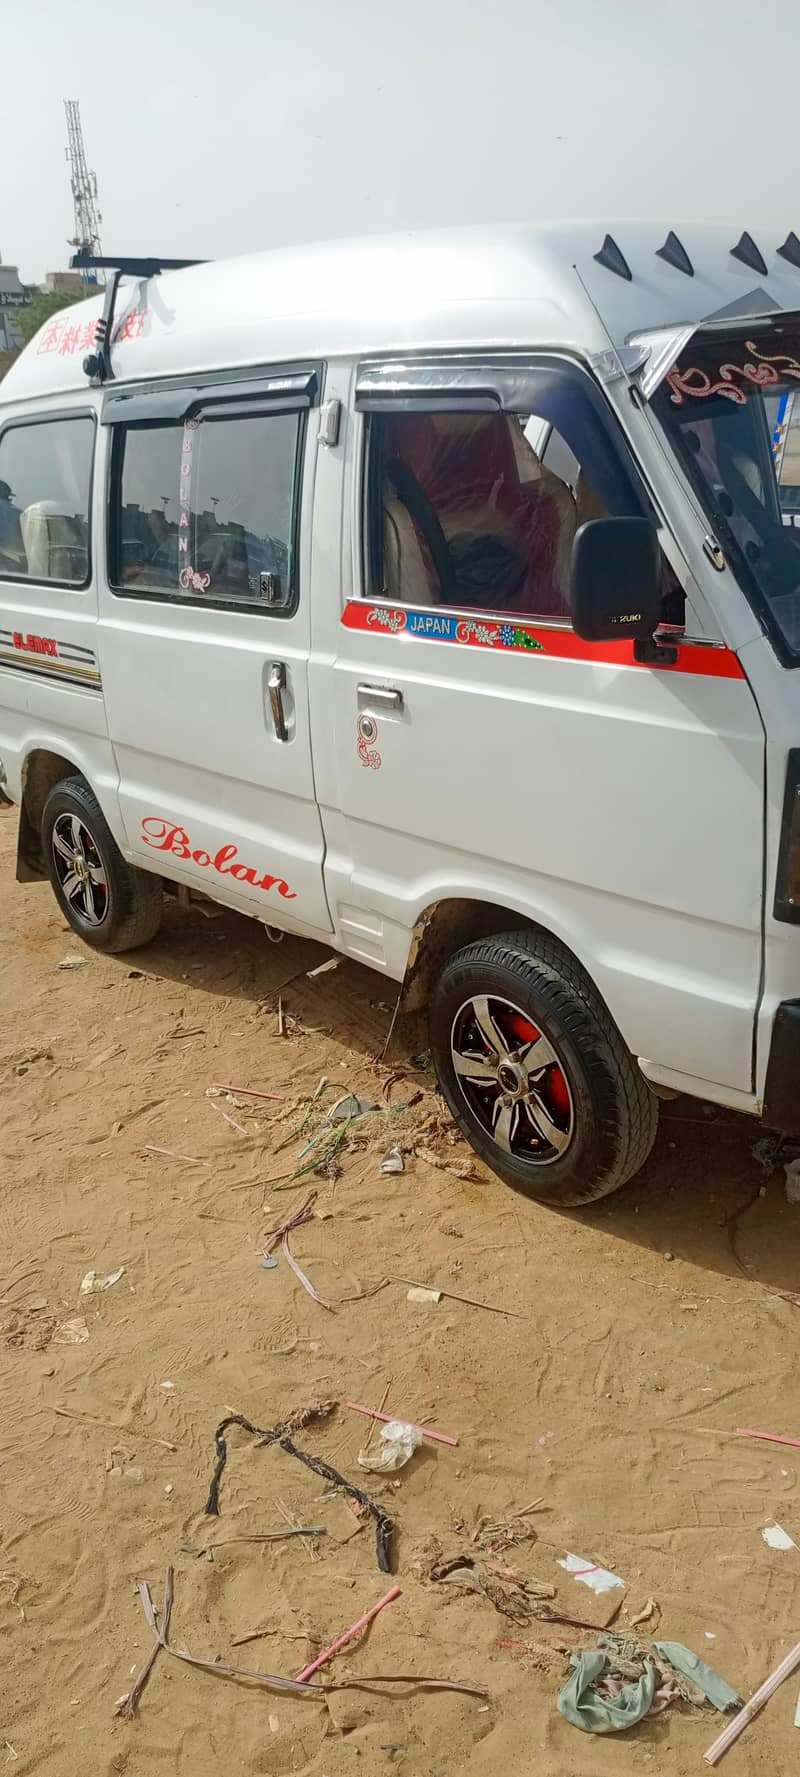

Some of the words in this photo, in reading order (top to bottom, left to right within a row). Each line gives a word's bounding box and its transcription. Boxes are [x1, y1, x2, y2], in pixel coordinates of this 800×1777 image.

[178, 439, 192, 553] BOLAN
[410, 616, 451, 635] JAPAN
[141, 817, 297, 899] Bolan
